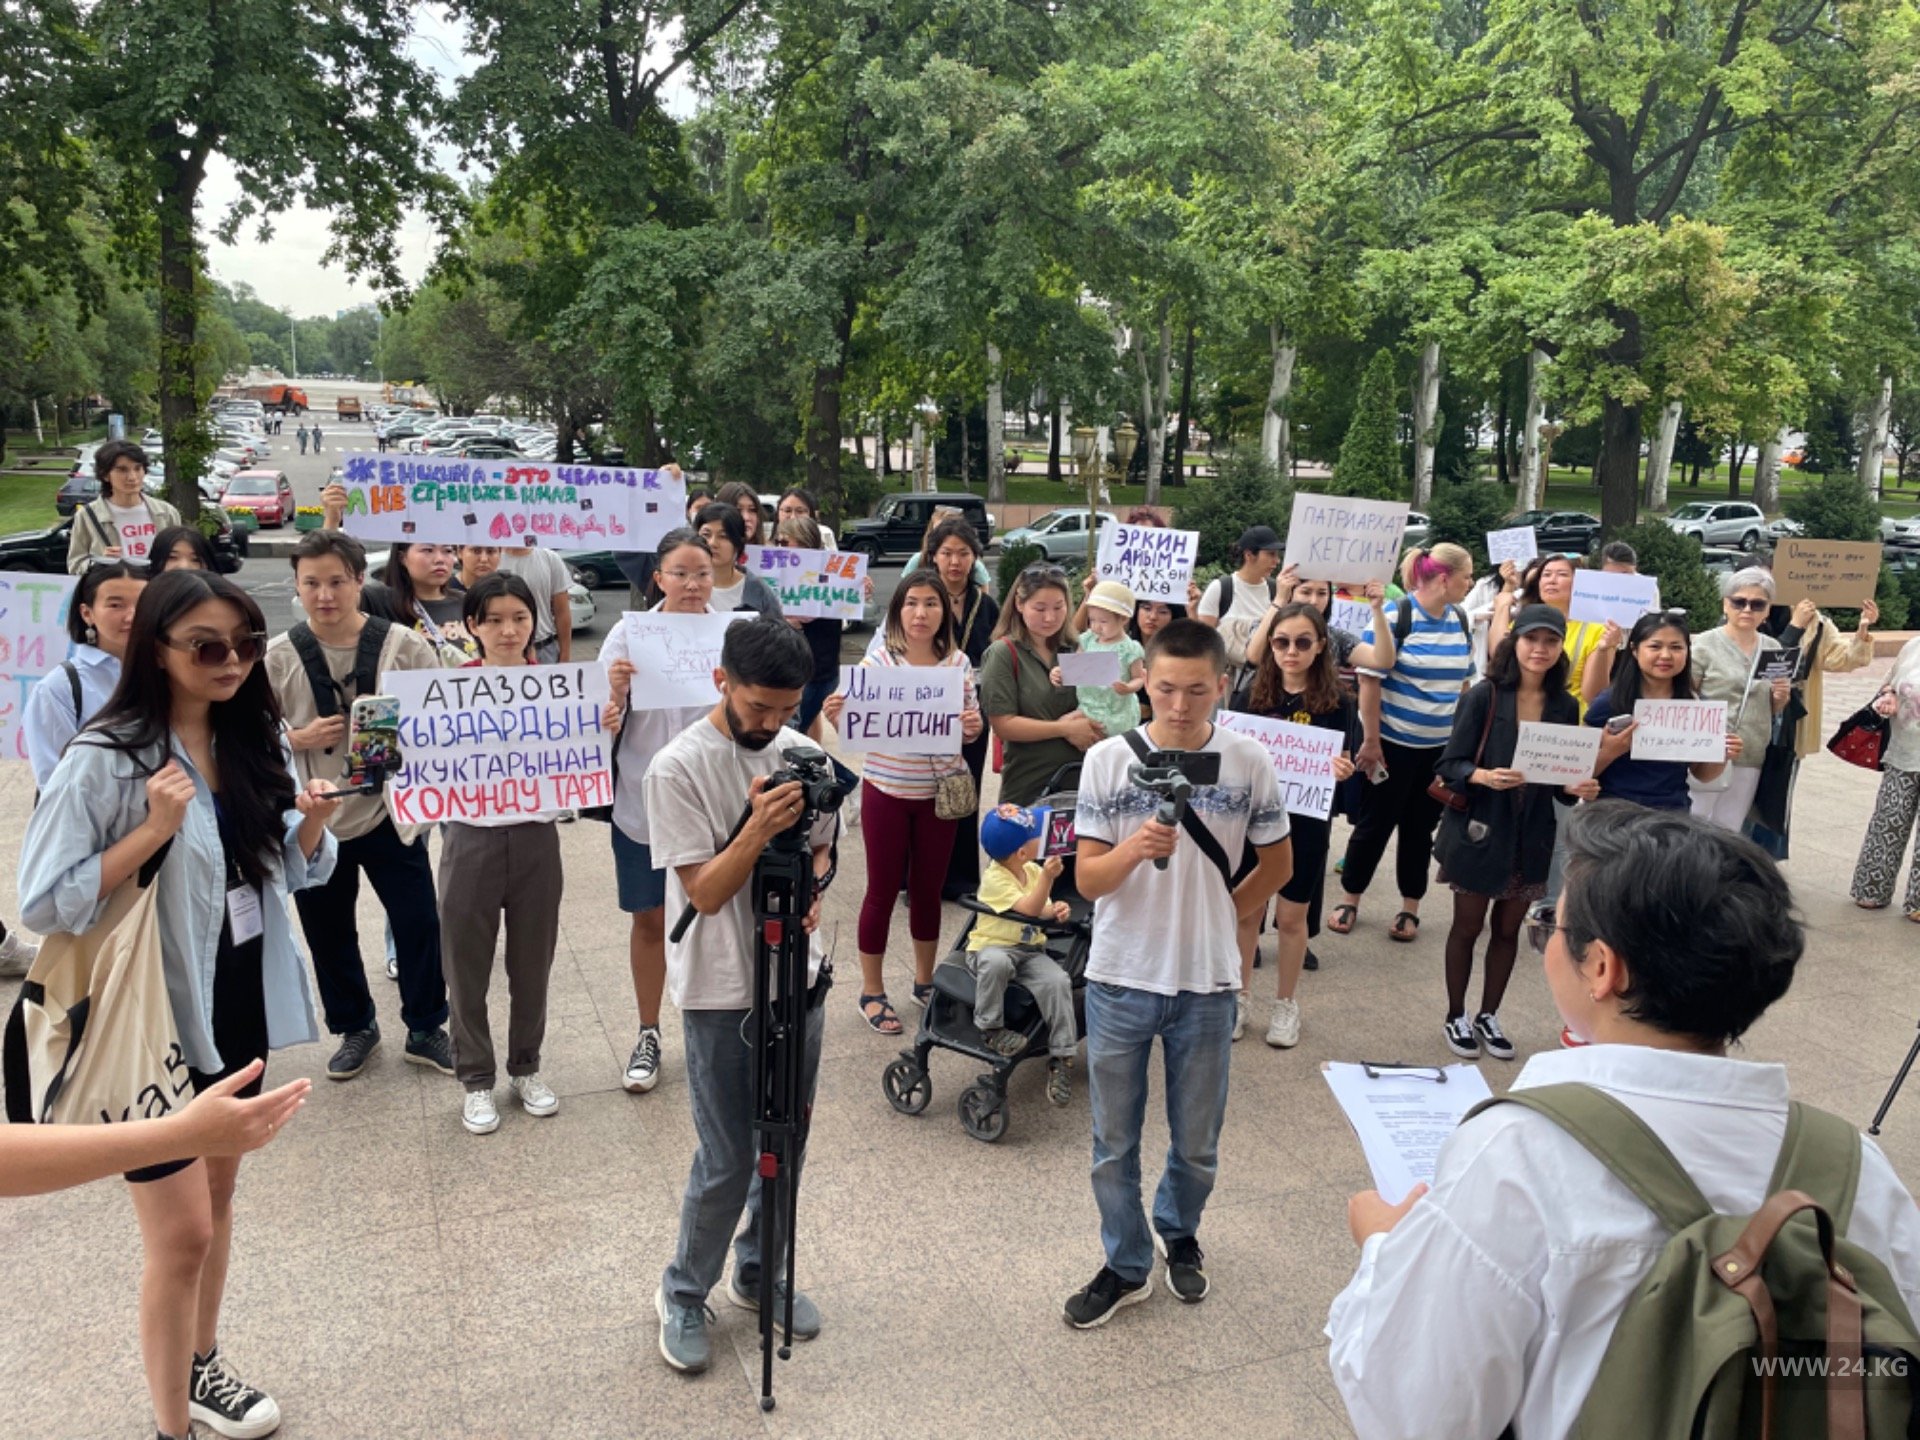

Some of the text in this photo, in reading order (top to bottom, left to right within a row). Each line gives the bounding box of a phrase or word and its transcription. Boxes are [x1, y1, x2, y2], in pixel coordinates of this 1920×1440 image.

[345, 457, 486, 484] ЖЕНЩИНА
[505, 467, 550, 485] ЭТО
[557, 467, 661, 490] ЧЕЛОВЕК
[371, 485, 405, 514] НЕ
[490, 512, 625, 539] ЛОШАДЬ
[1303, 506, 1405, 534] ПАТРИАРХАТ
[128, 542, 146, 556] IS
[1115, 529, 1187, 554] ЭРКИН
[1309, 537, 1398, 563] КЕТСИН!
[760, 550, 859, 579] ЭТО НЕ
[1120, 548, 1172, 570] АЙЫМ
[422, 669, 584, 710] АТАЗОВ!
[843, 667, 881, 701] Мы
[847, 711, 959, 740] РЕЙТИНГ
[1641, 705, 1724, 734] ЗАПРЕТИТЕ
[394, 777, 541, 824] КОЛУНДУ
